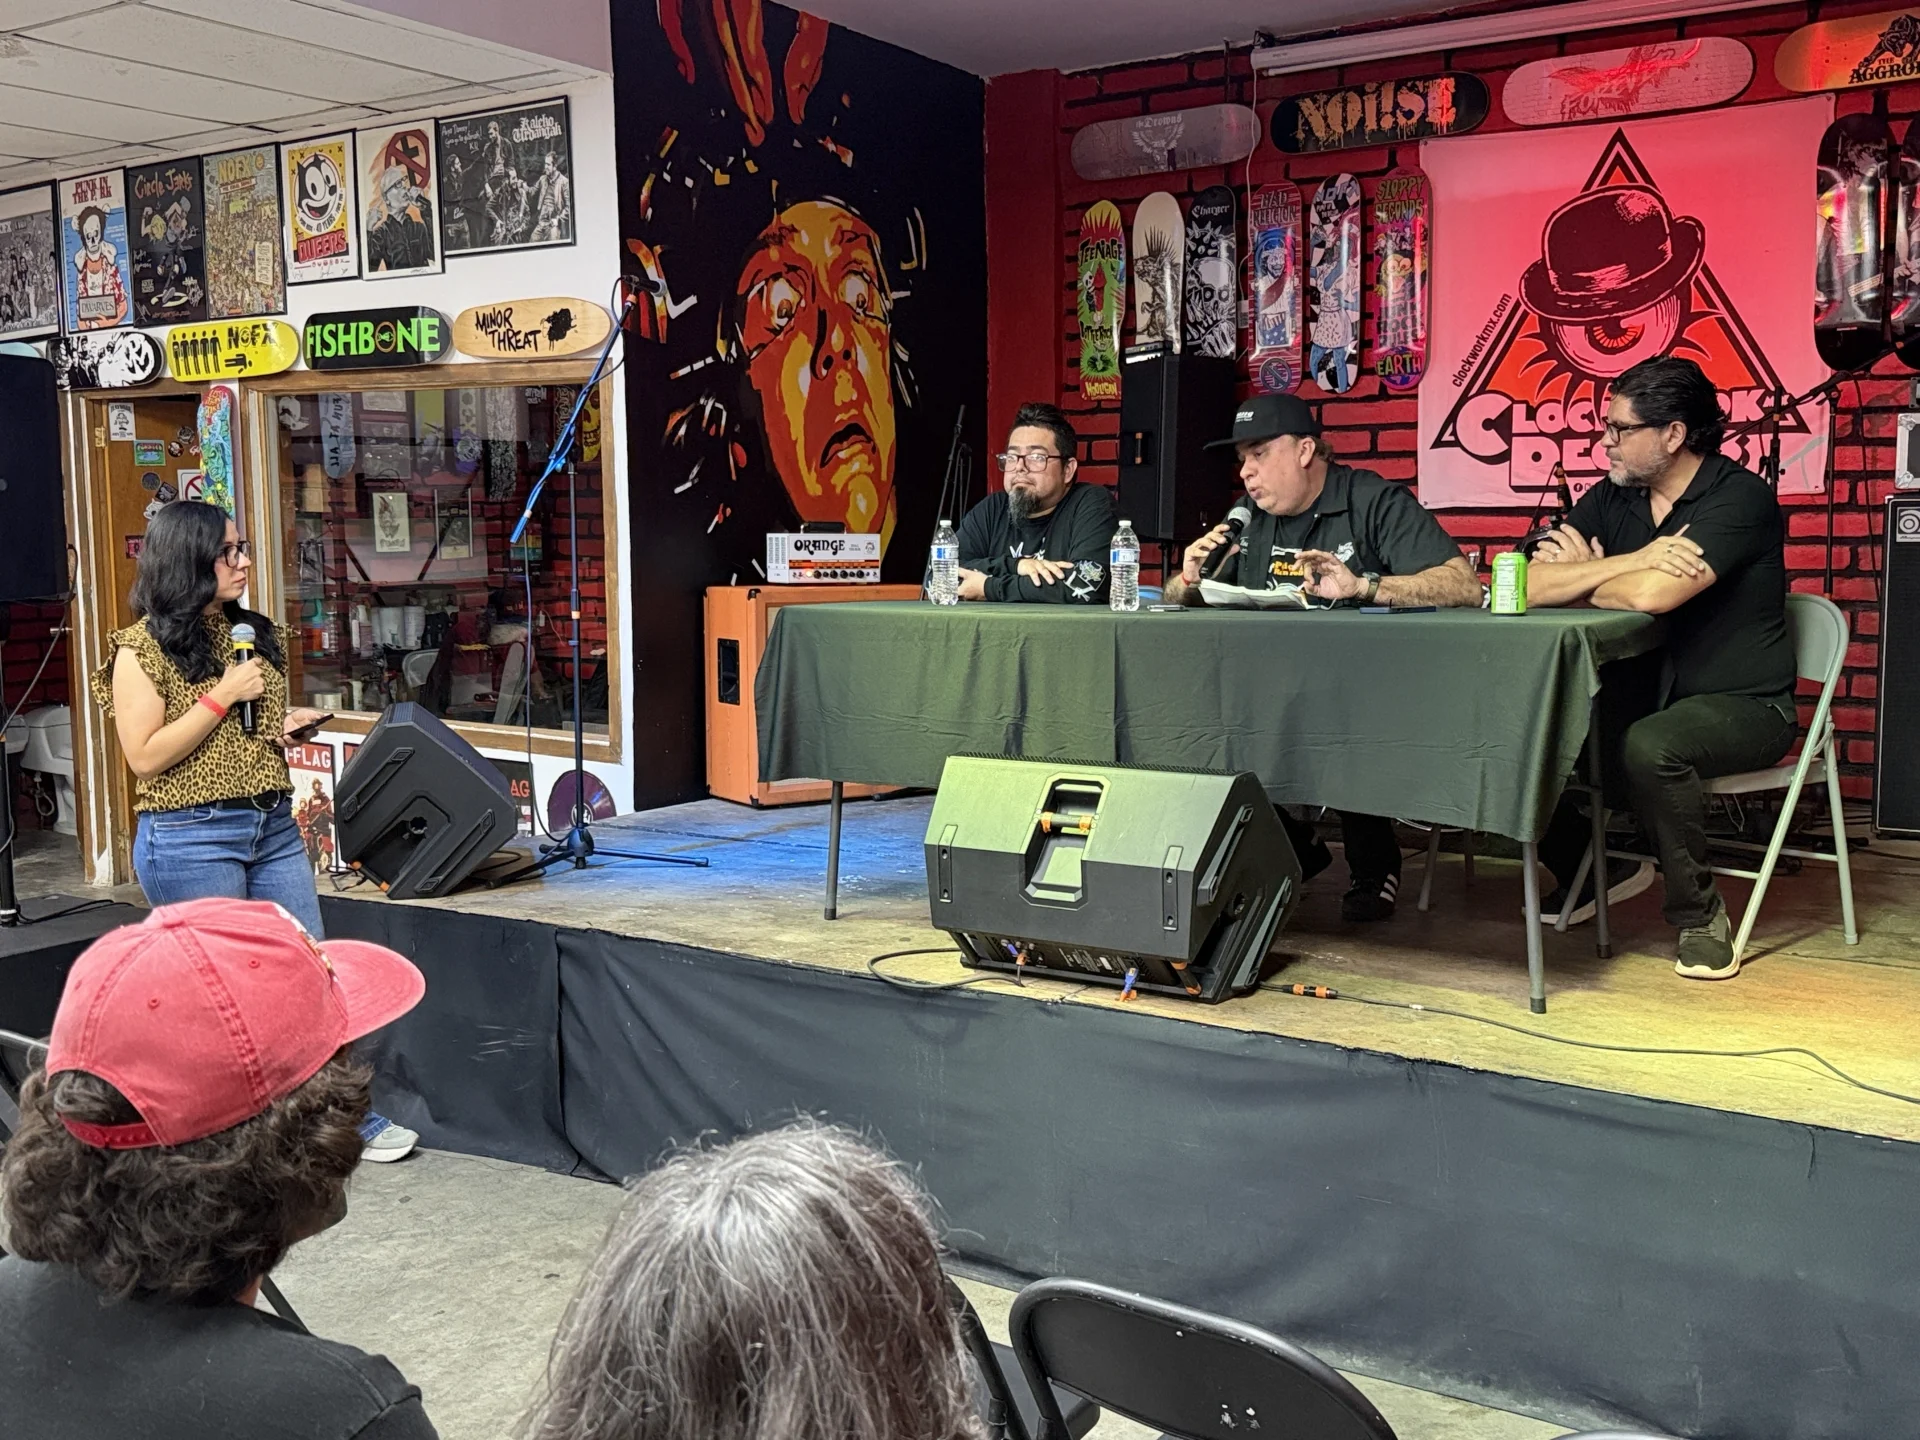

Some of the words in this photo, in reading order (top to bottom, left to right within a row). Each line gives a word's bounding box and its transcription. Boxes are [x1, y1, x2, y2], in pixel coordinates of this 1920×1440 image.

[1878, 57, 1894, 65] THE
[1144, 113, 1182, 128] Drowns
[218, 155, 252, 183] NOFX
[72, 190, 89, 204] THE
[90, 186, 112, 201] PRK
[75, 178, 97, 194] PUNK
[99, 175, 108, 188] IN
[135, 172, 165, 199] Circle
[1377, 176, 1426, 200] SLOPPY
[1191, 204, 1230, 218] Charger
[1261, 191, 1287, 208] BAD
[1375, 199, 1424, 223] SECONDS
[1253, 206, 1296, 226] RELIGION
[298, 229, 346, 263] QUEERS
[1079, 238, 1123, 266] TEENAGE
[81, 300, 114, 313] DWARVES
[475, 307, 513, 331] MINOR
[227, 322, 278, 349] NOFX
[306, 317, 440, 359] FISHBONE
[488, 329, 541, 352] THREAT
[1452, 293, 1512, 388] clockworkmx.com
[1377, 353, 1421, 376] EARTH
[1085, 382, 1117, 396] HOOLIGAN
[794, 539, 845, 556] ORANGE
